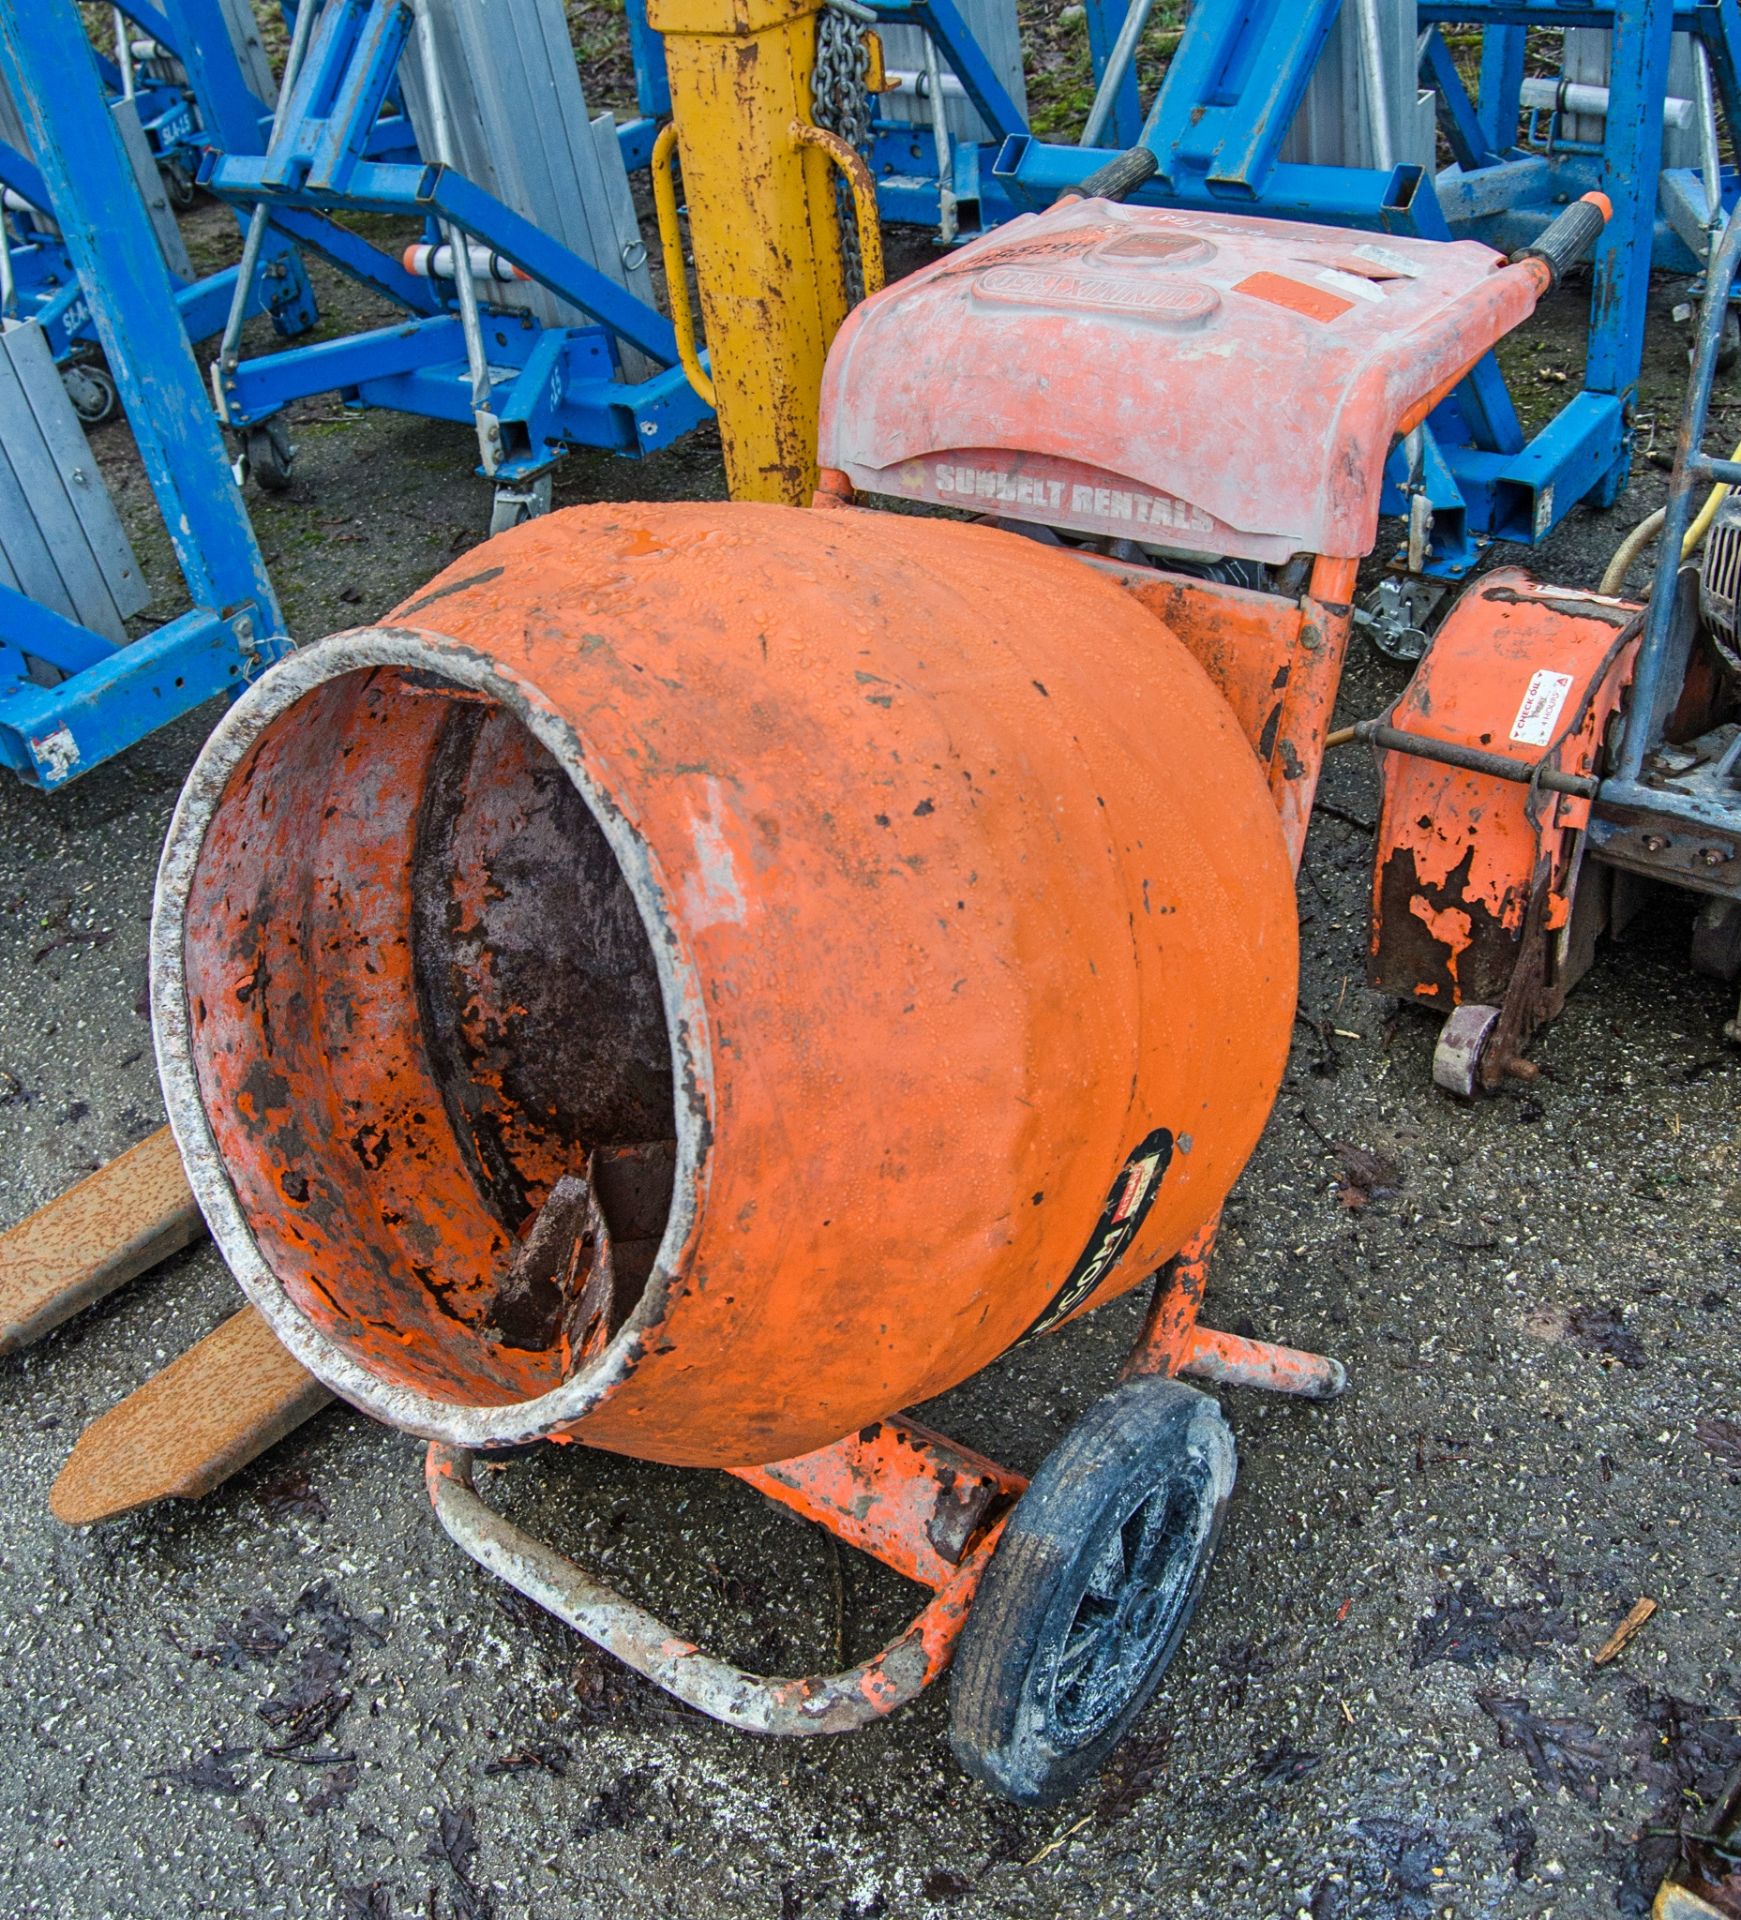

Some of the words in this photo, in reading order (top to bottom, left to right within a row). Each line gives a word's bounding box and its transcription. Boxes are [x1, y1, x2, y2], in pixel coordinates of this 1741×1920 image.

[935, 463, 1065, 507] SUNBELT
[1071, 484, 1214, 534] RENTALS
[1517, 698, 1534, 729] CHECK
[1530, 682, 1541, 696] OIL
